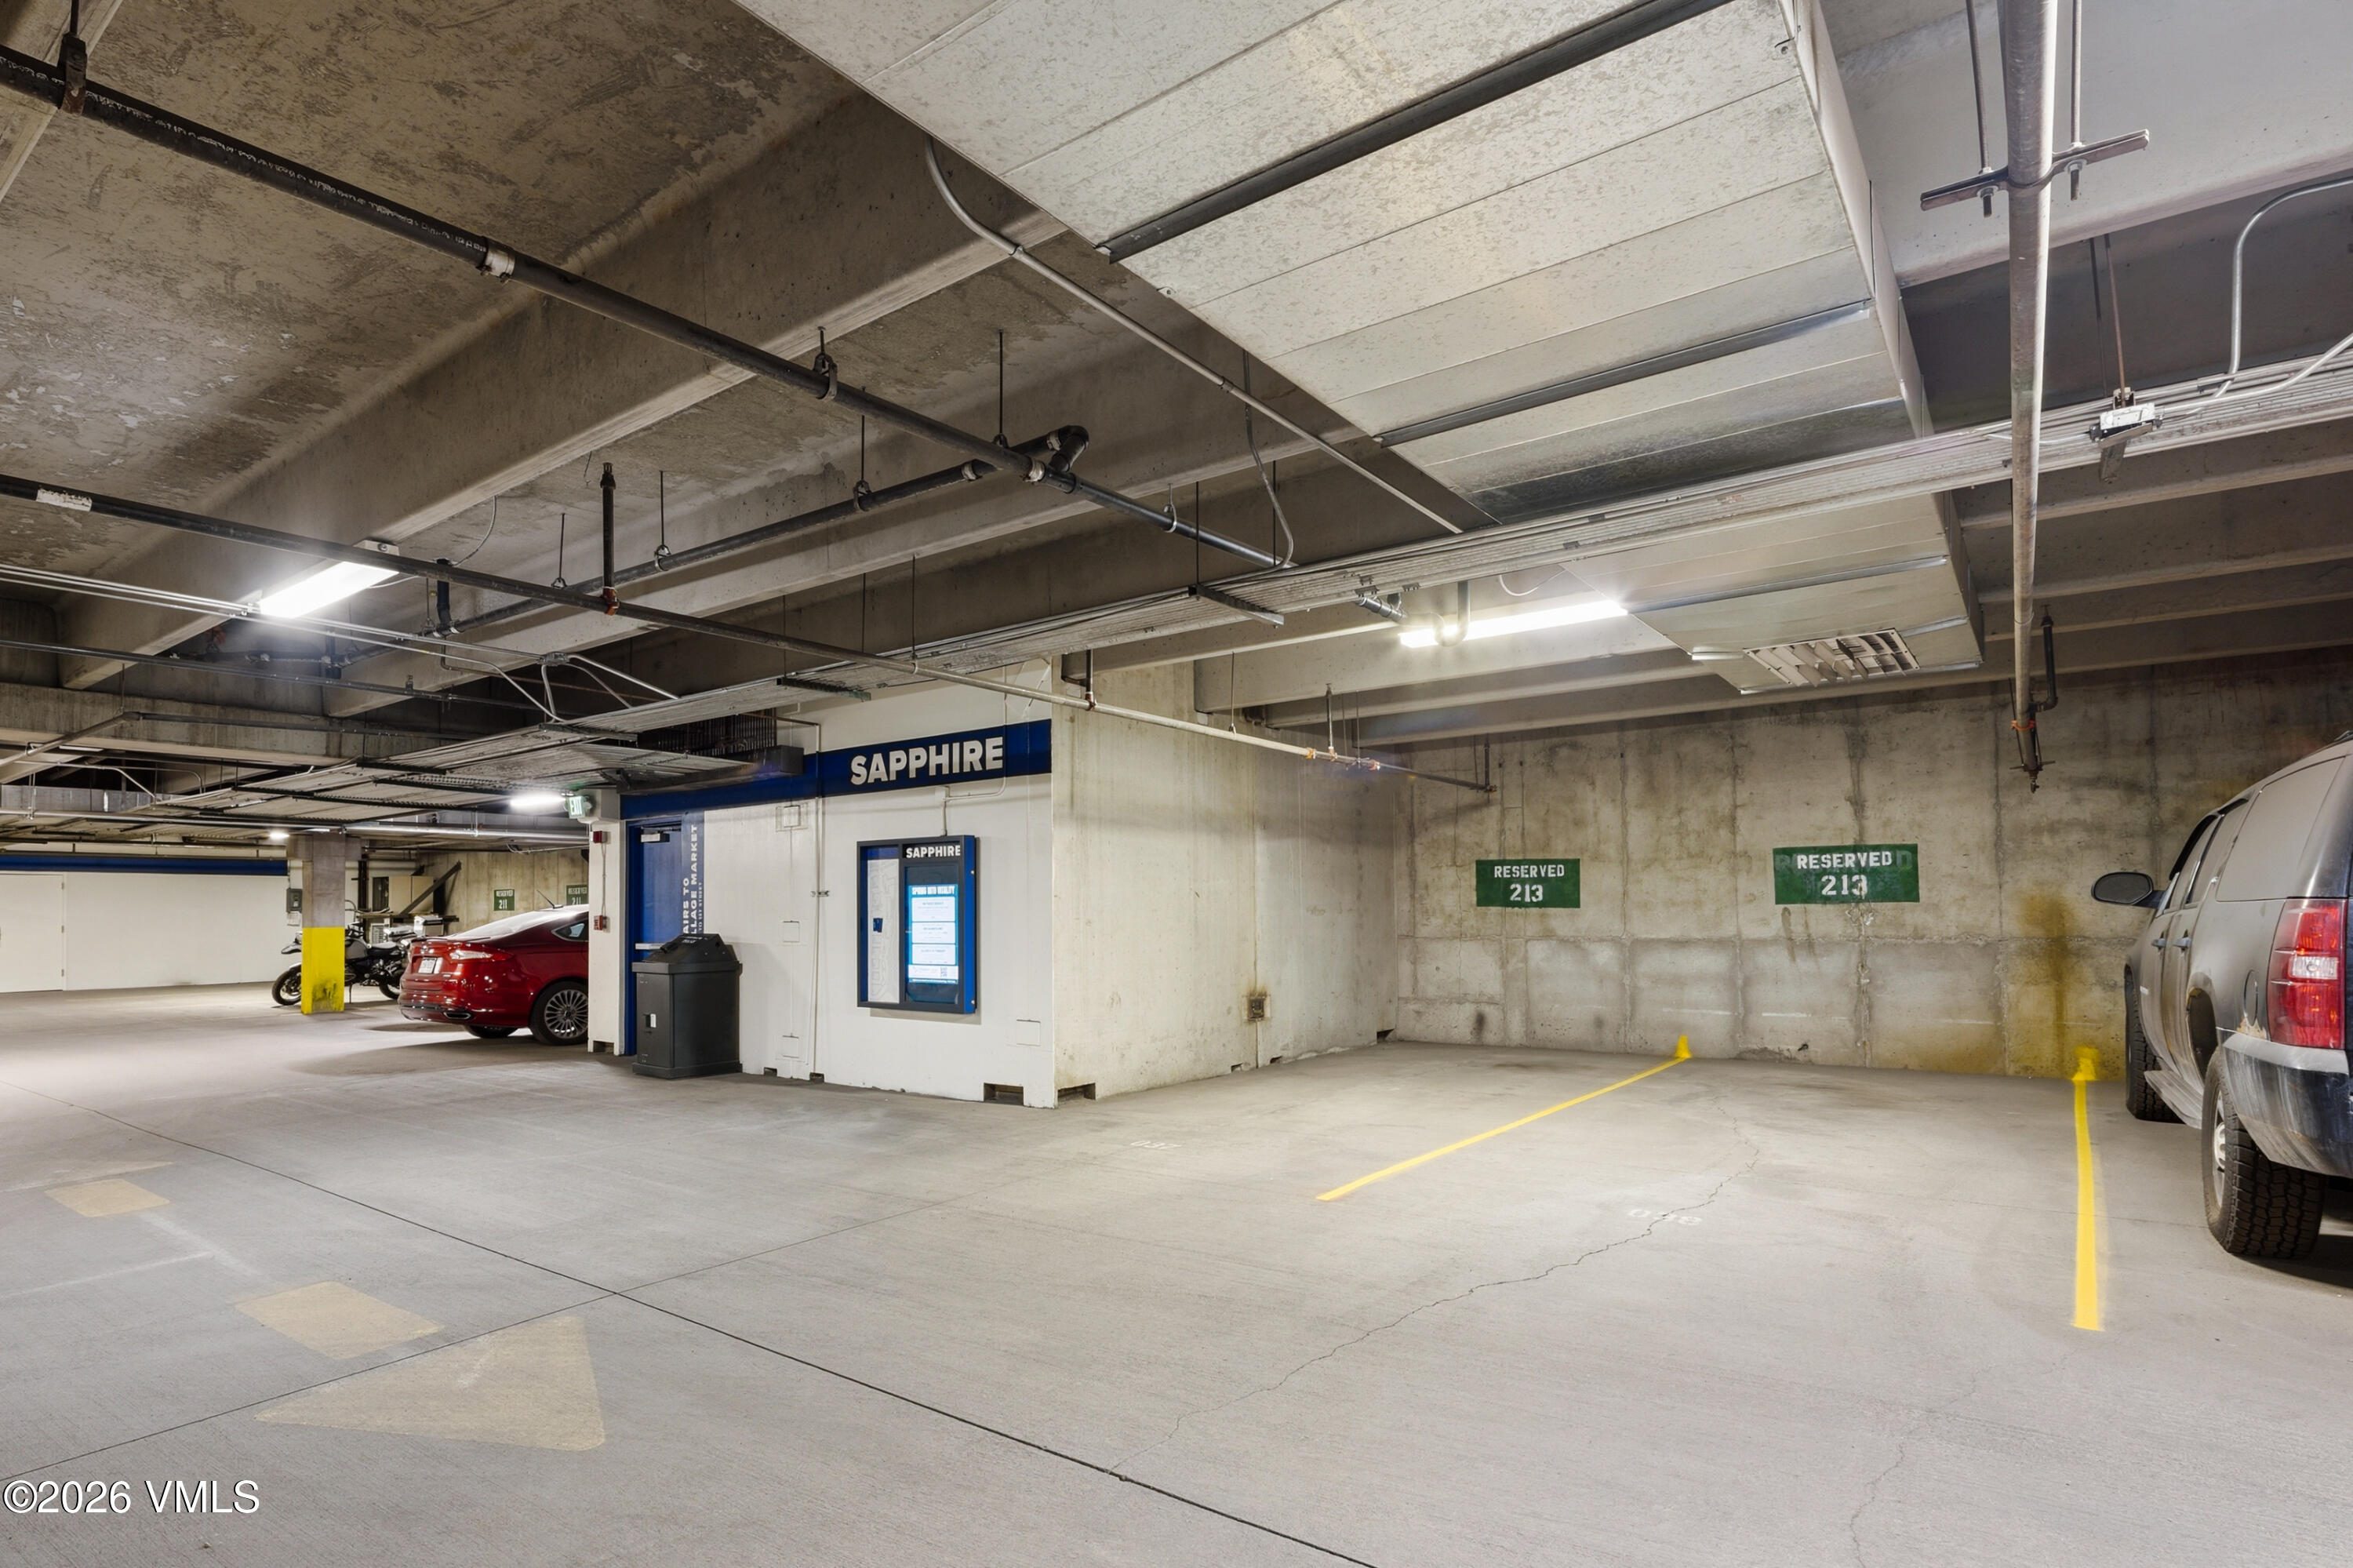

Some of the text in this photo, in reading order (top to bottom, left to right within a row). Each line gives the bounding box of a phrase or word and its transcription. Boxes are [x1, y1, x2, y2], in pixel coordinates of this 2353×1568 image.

[850, 737, 1003, 785] SAPPHIRE
[569, 795, 583, 816] EXIT
[906, 845, 961, 858] SAPPHIRE
[1797, 851, 1893, 869] RESERVED
[1494, 864, 1565, 878] RESERVED
[682, 878, 689, 896] TO
[1510, 883, 1543, 903] 213
[1821, 874, 1868, 897] 213
